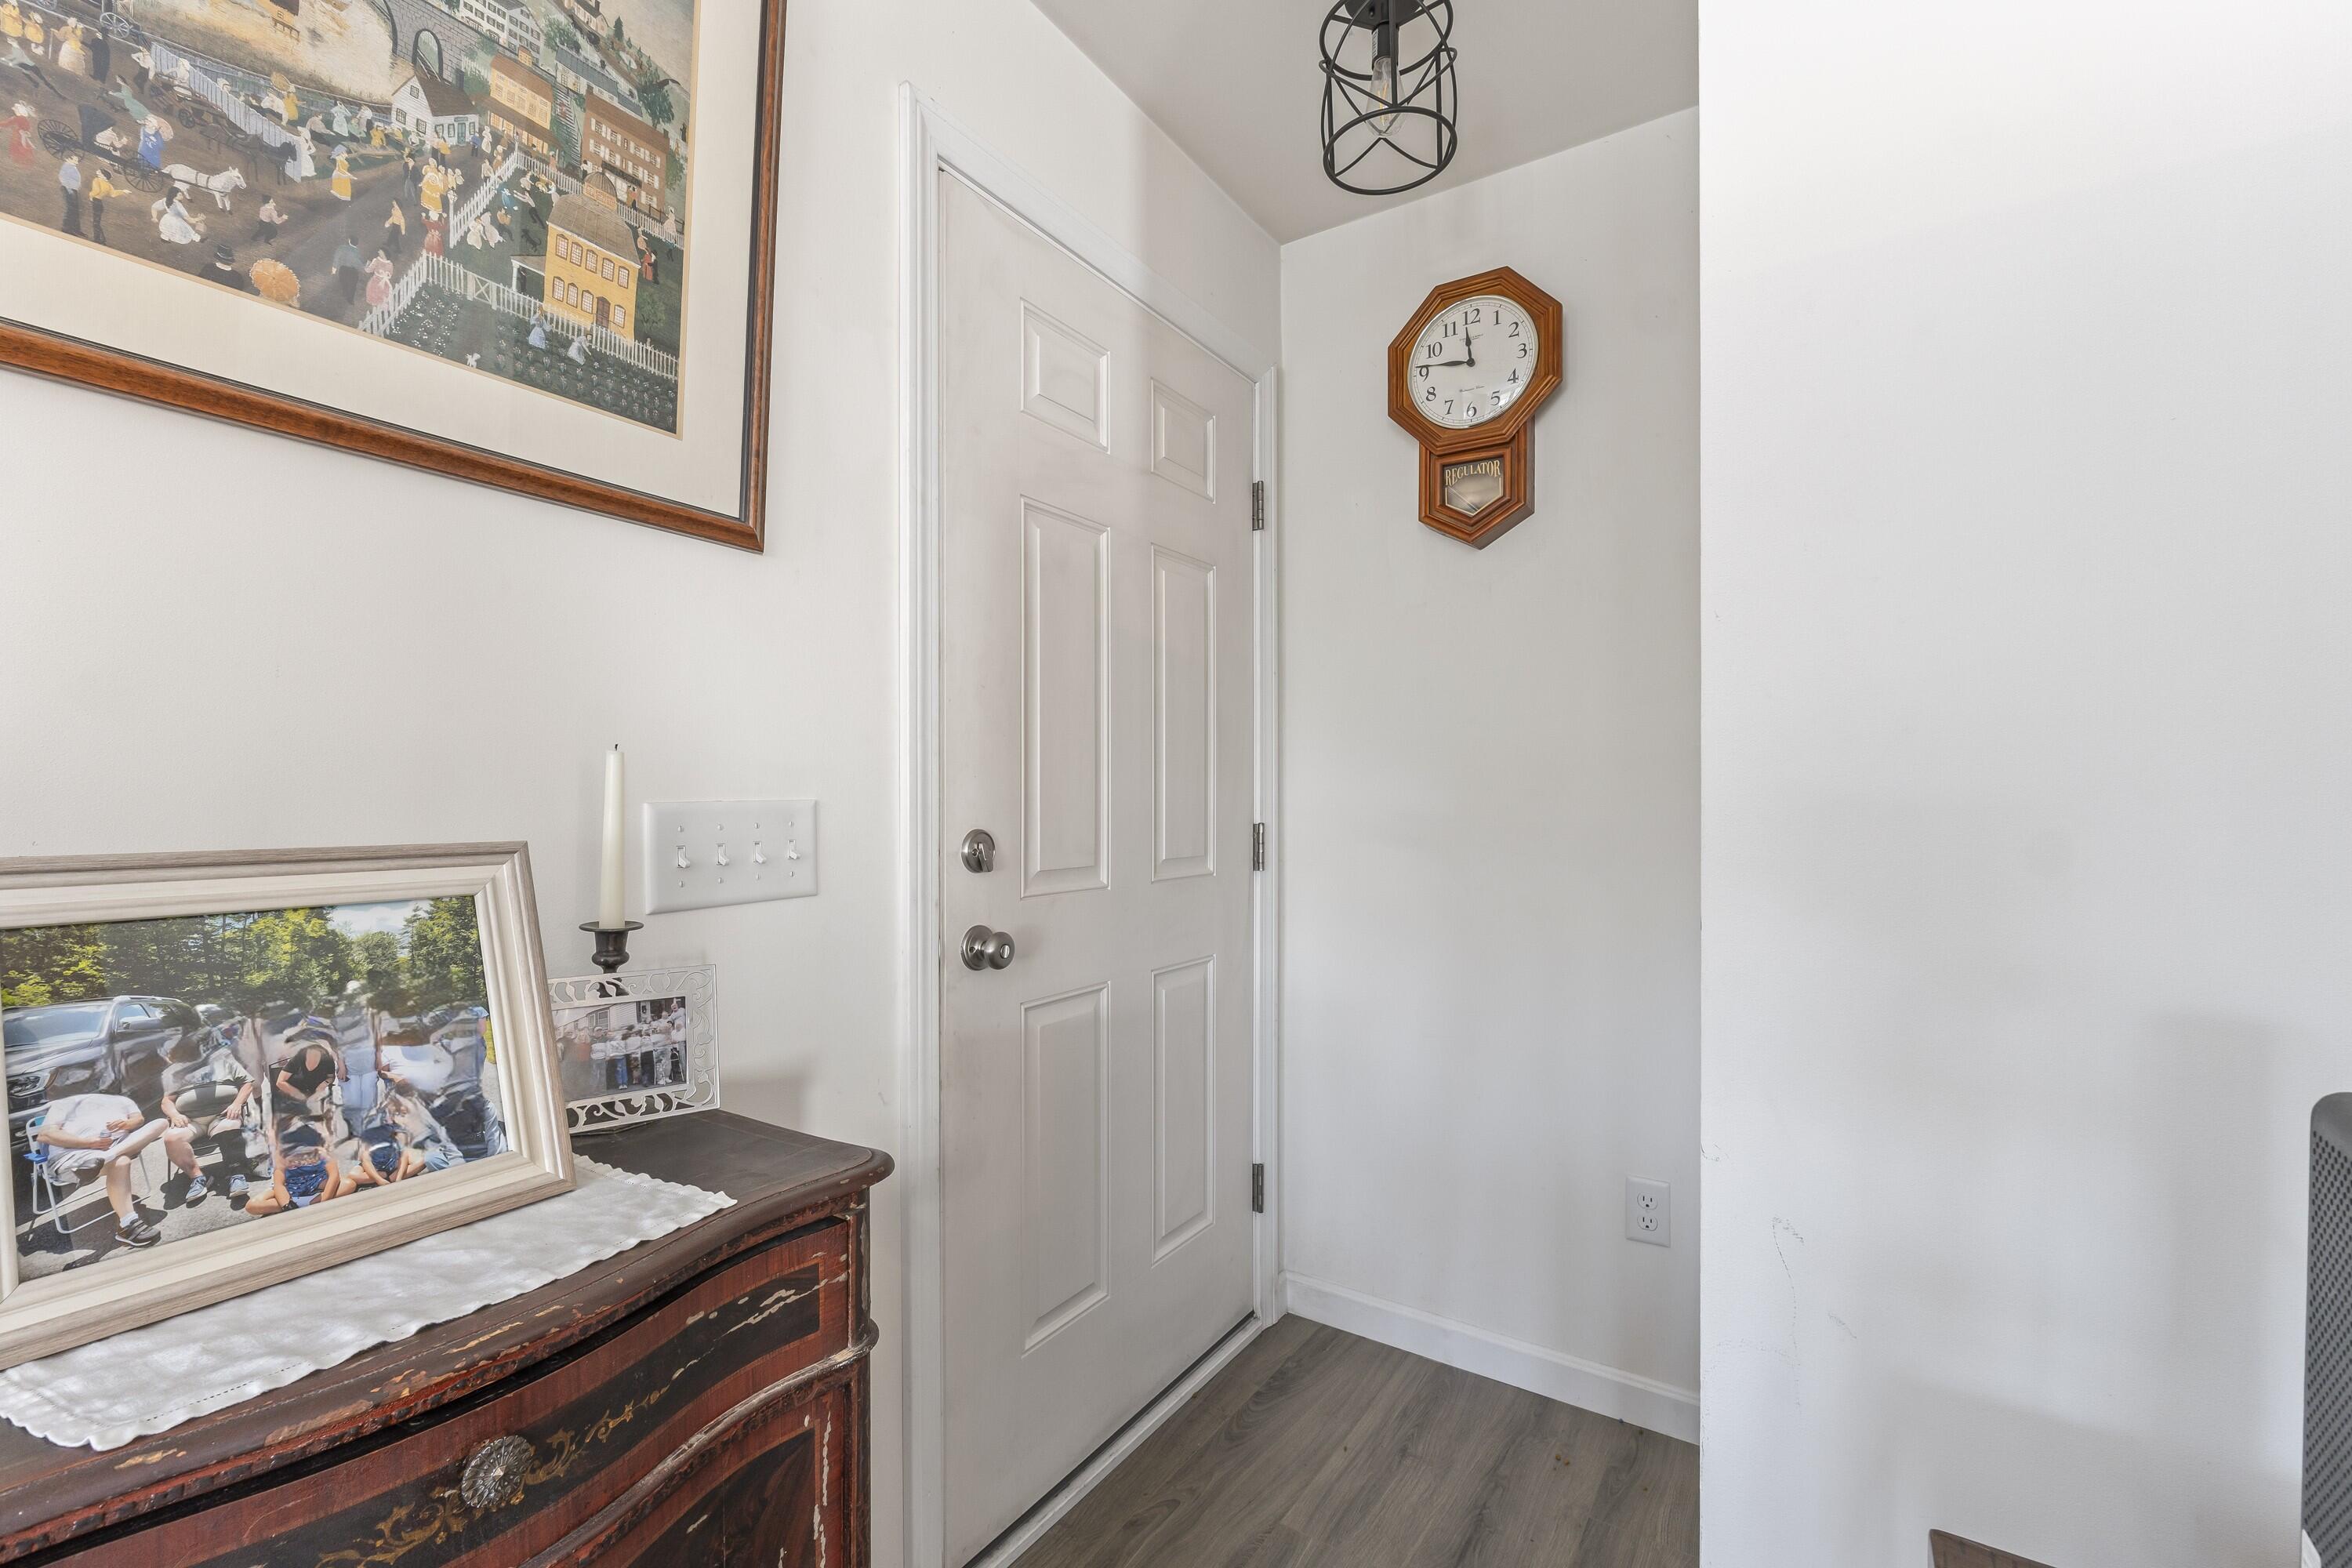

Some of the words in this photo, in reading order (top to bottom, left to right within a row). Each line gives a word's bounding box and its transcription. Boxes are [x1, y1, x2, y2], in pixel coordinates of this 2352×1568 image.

[1462, 308, 1481, 326] 12
[1493, 310, 1501, 326] 1
[1442, 321, 1458, 339] 11
[1508, 321, 1519, 338] 2
[1426, 341, 1443, 359] 10
[1516, 343, 1527, 359] 3
[1419, 365, 1429, 382] 9
[1507, 368, 1519, 384] 4
[1425, 387, 1436, 401] 8
[1490, 390, 1501, 406] 5
[1444, 399, 1454, 416] 7
[1466, 401, 1477, 418] 6
[1445, 459, 1501, 486] REGULATOR
